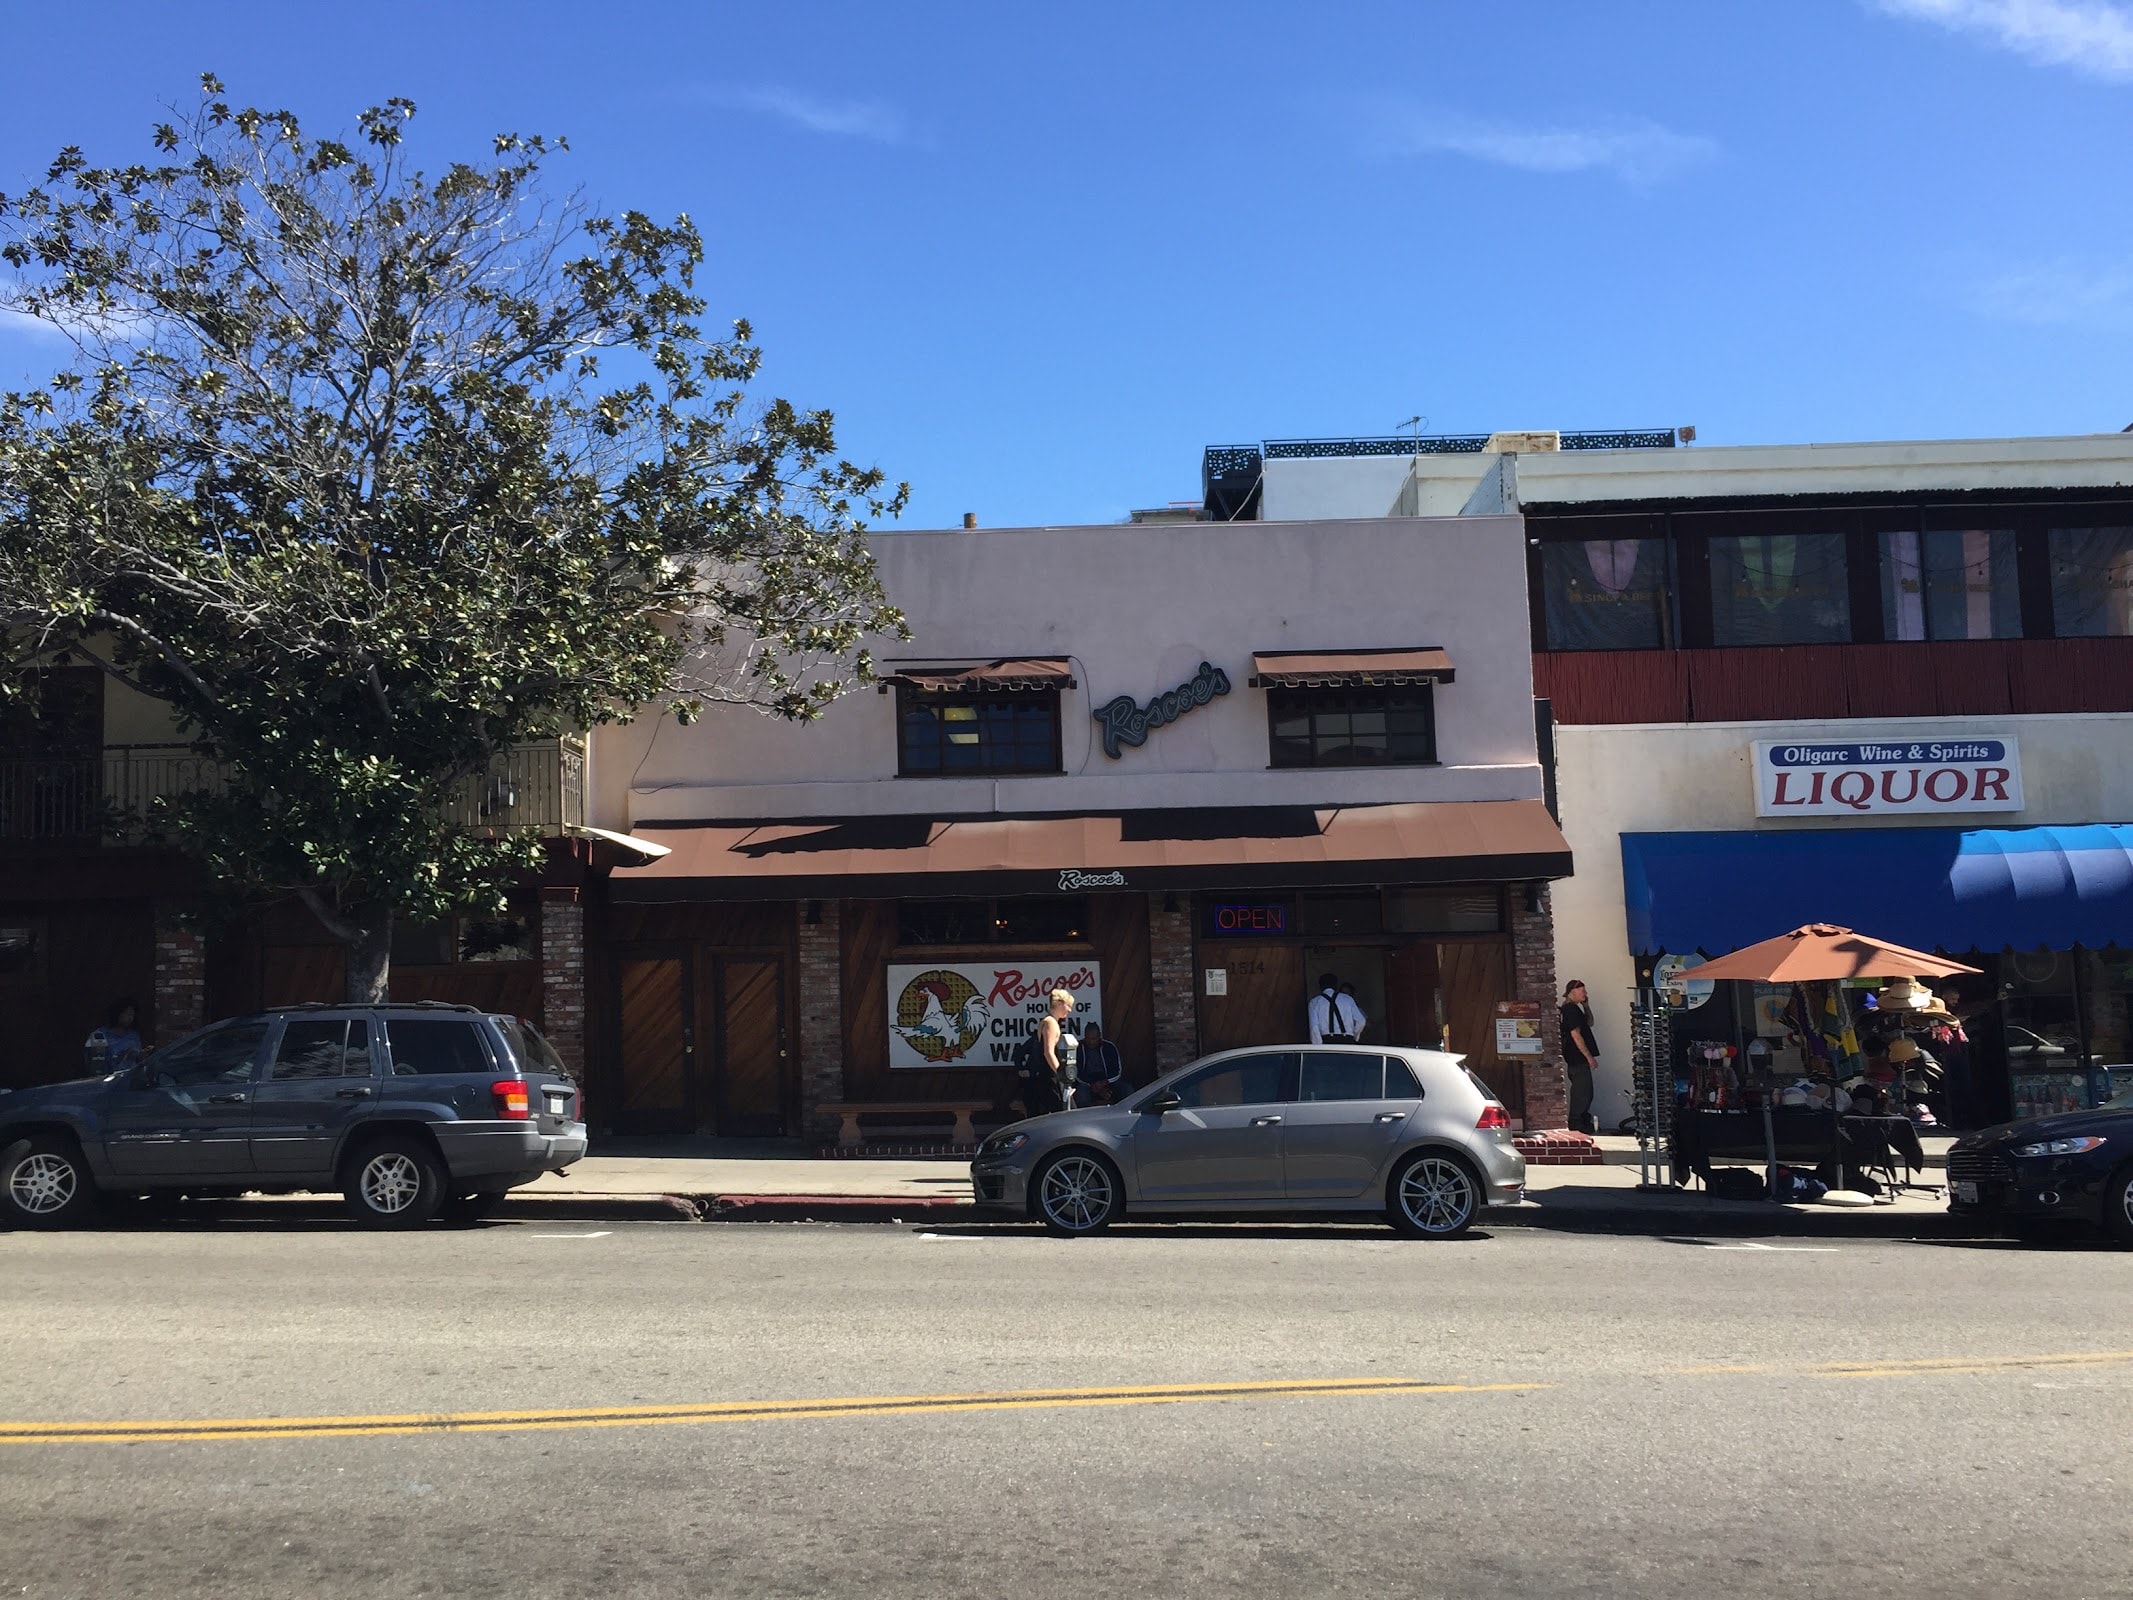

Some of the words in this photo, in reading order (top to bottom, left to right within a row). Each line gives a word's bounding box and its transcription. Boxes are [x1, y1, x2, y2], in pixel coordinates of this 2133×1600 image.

[1093, 661, 1231, 759] Roscoe's
[1784, 747, 1849, 765] Oligarc
[1860, 745, 1902, 761] Wine
[1907, 744, 1924, 760] &
[1929, 743, 1989, 761] Spirits
[1771, 767, 2010, 810] LIQUOR
[1058, 870, 1124, 891] Roscoe's
[1218, 908, 1283, 929] OPEN
[1231, 960, 1265, 976] 1514
[988, 967, 1096, 1008] Roscoe's
[1076, 1002, 1092, 1013] OF
[990, 1017, 1081, 1037] CHICEN
